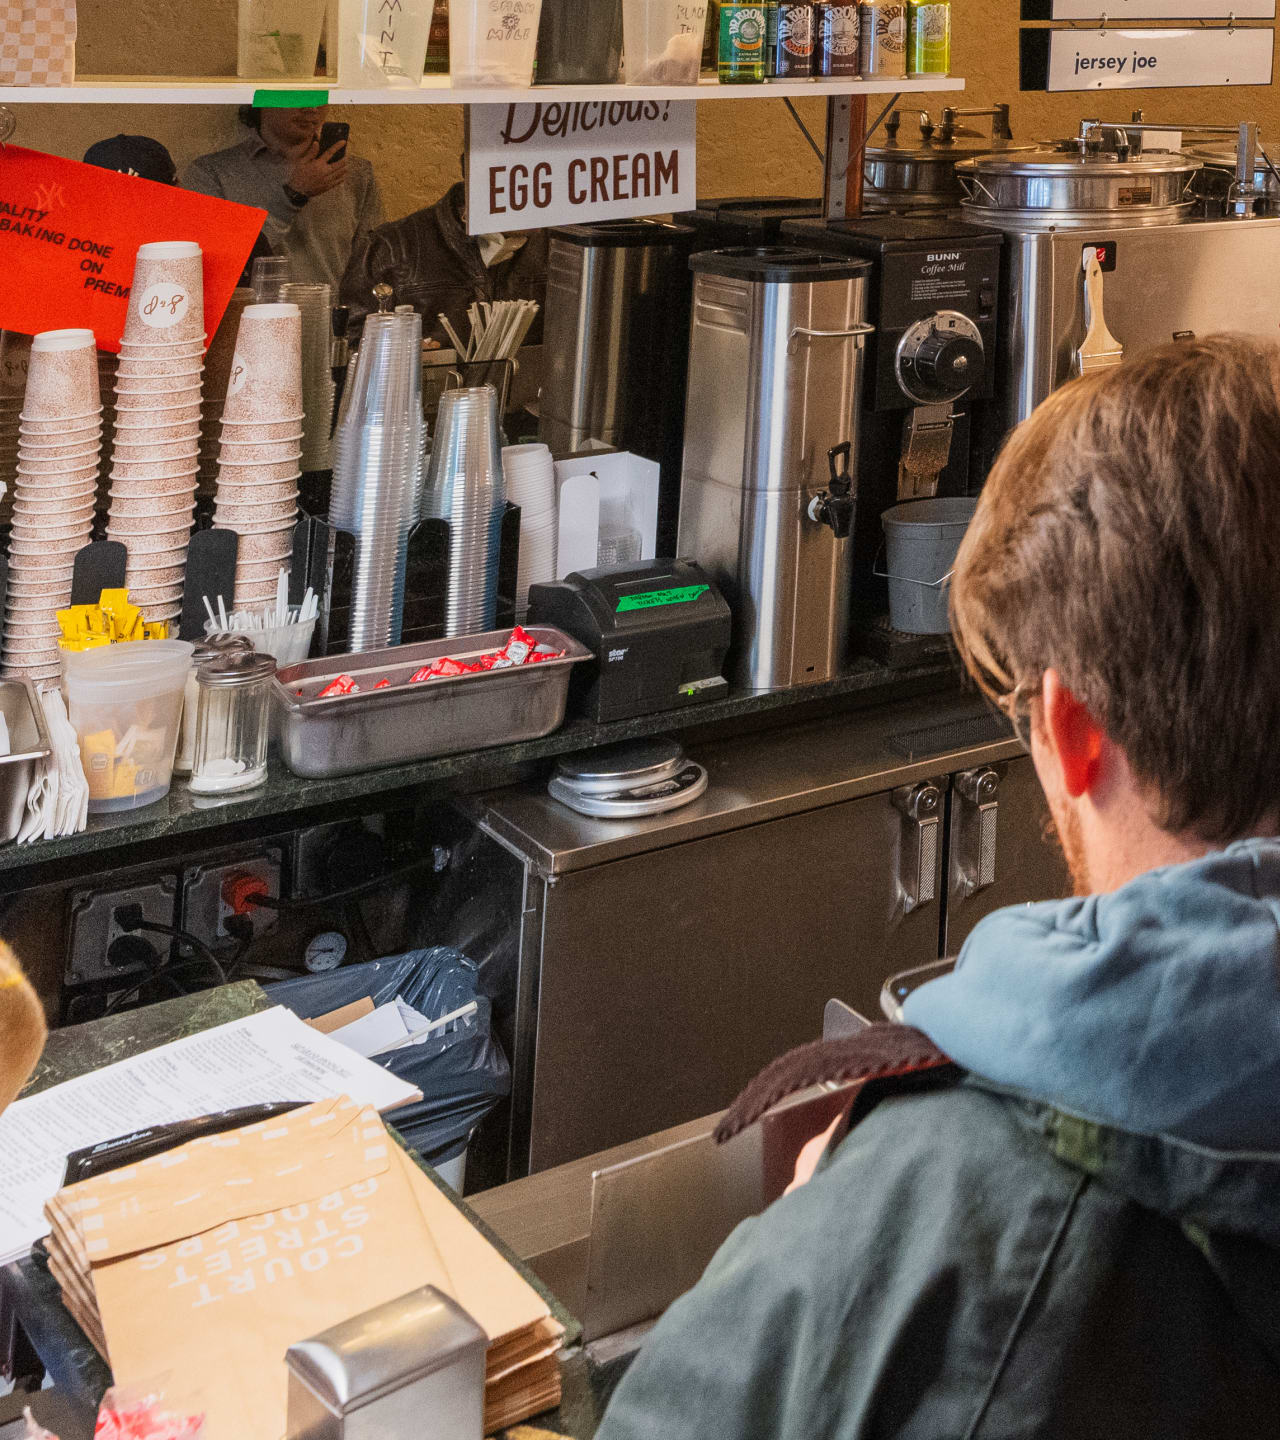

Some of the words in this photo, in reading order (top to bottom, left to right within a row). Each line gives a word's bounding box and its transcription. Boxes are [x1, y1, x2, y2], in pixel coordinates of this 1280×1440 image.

[1074, 51, 1127, 75] jersey
[1132, 51, 1157, 72] joe
[489, 162, 552, 215] EGG
[568, 150, 679, 205] CREAM
[0, 201, 49, 223] ALITY
[0, 218, 66, 245] BAKING
[68, 238, 114, 259] DONE
[80, 259, 104, 275] ON
[921, 264, 946, 276] Coffee
[947, 262, 965, 273] Mill
[927, 253, 960, 262] BUNN
[84, 277, 131, 300] PREM
[168, 1205, 370, 1289] STREET
[192, 1234, 363, 1308] COURT
